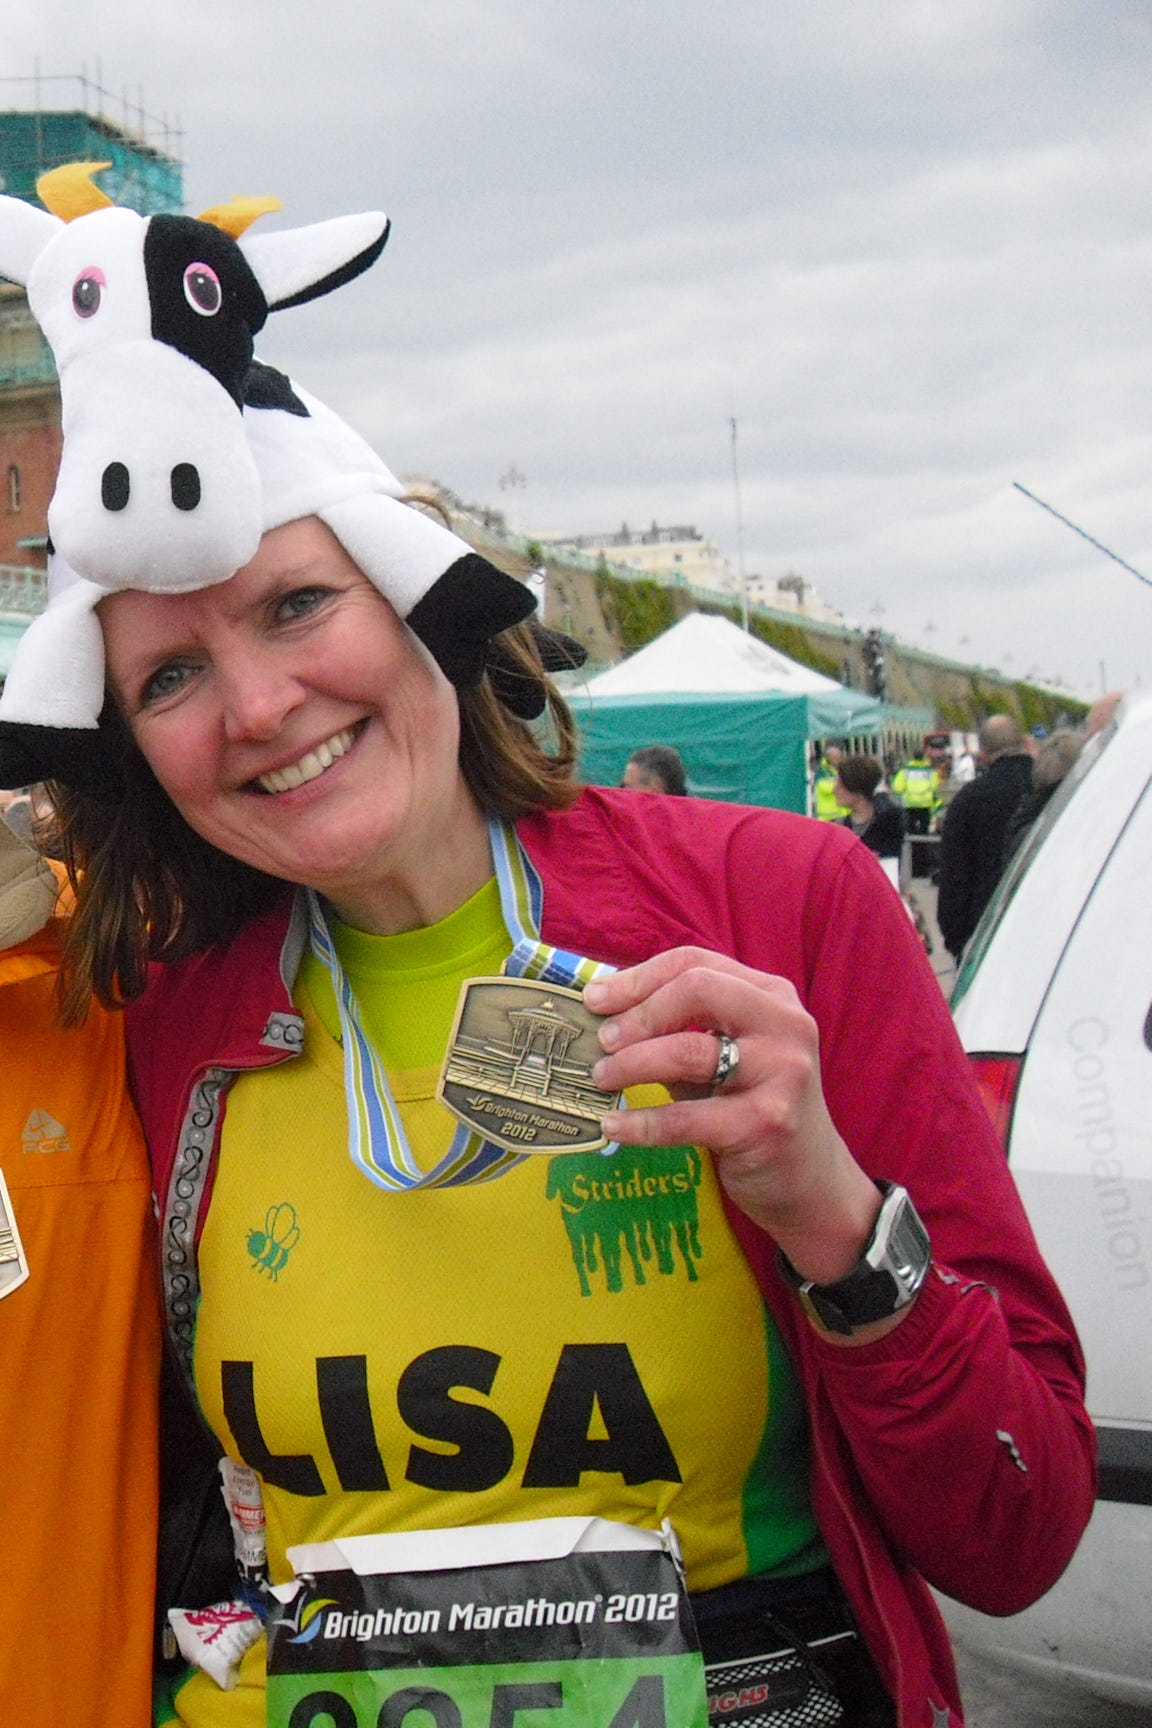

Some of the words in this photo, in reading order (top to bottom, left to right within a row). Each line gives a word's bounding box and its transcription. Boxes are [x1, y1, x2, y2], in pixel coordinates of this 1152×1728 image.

[483, 1102, 528, 1124] Brighton
[529, 1113, 580, 1137] Marathon
[500, 1122, 538, 1142] 2012
[1064, 1015, 1149, 1292] Companion
[560, 1167, 690, 1214] Striders
[221, 1343, 684, 1497] LISA
[323, 1610, 441, 1643] Brighton
[448, 1598, 596, 1632] Marathon
[604, 1592, 679, 1624] 2012
[708, 1684, 769, 1713] IGH5
